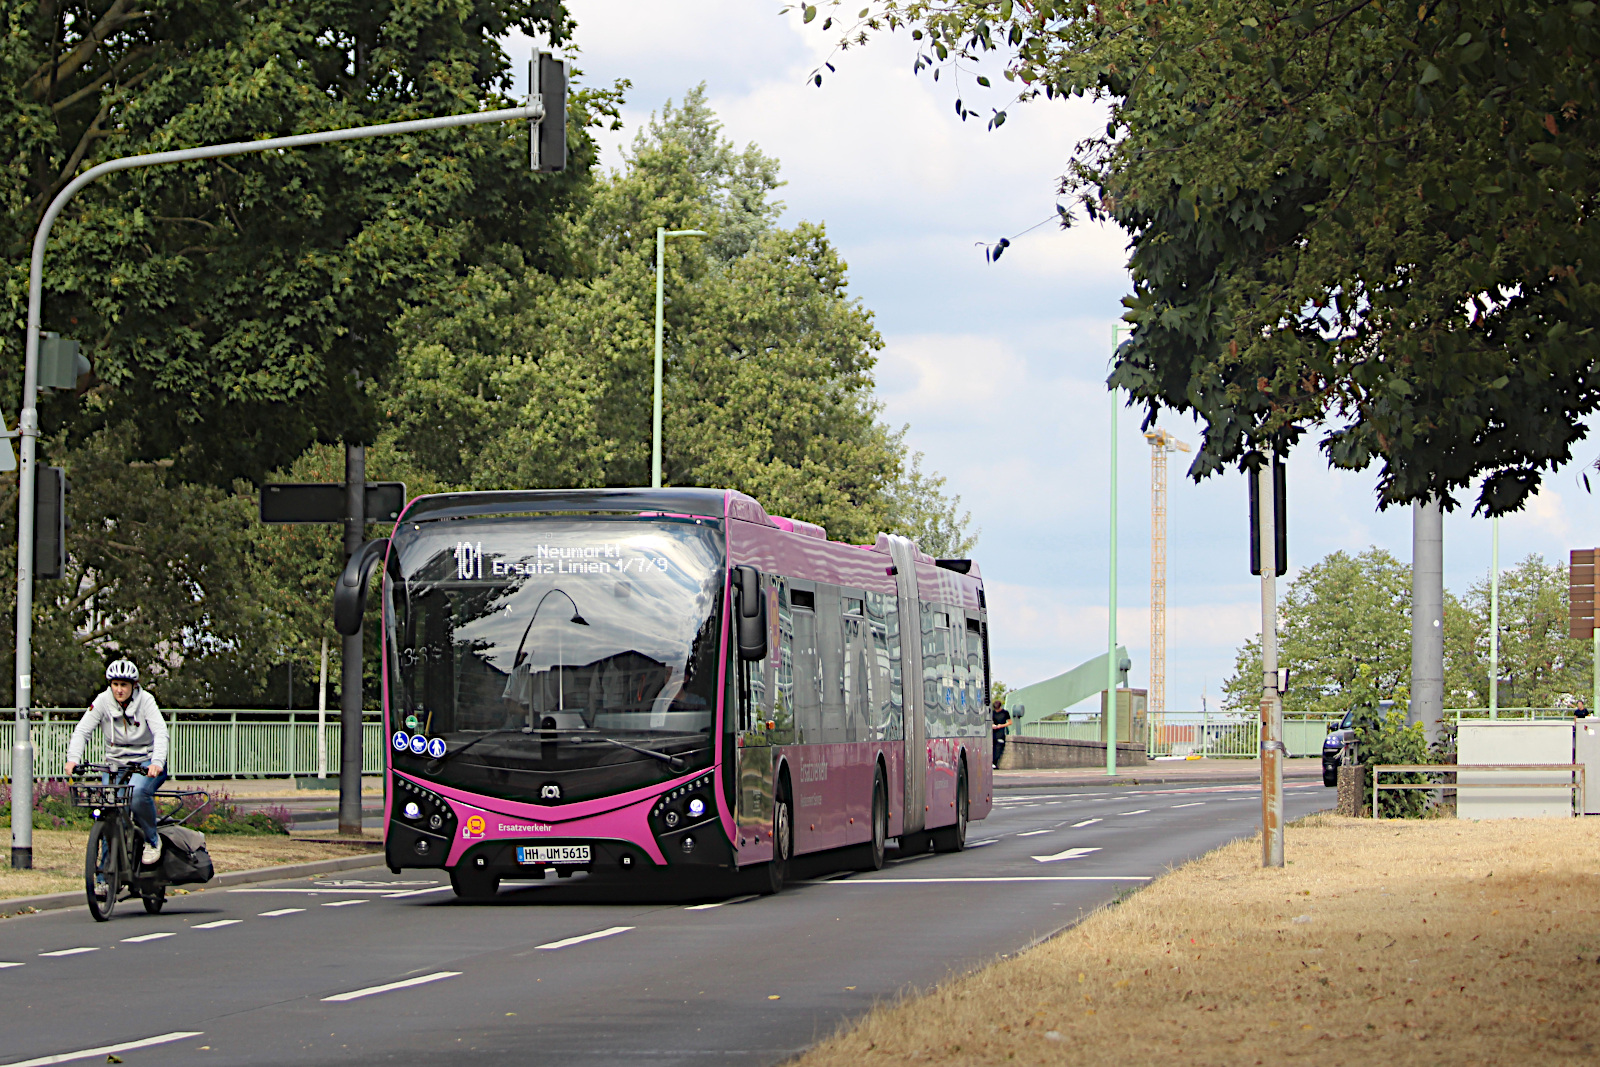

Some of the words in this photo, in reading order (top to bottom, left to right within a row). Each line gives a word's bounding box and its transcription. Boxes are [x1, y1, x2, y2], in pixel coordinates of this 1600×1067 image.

[537, 543, 621, 559] Neumarkt
[453, 541, 483, 579] 101
[492, 559, 554, 576] Ersatz
[558, 559, 611, 574] Linien
[614, 557, 669, 573] 1/7/9
[498, 823, 553, 832] Ersatzverkehr
[524, 848, 539, 860] HH
[546, 848, 561, 859] UM
[562, 847, 589, 859] 5615
